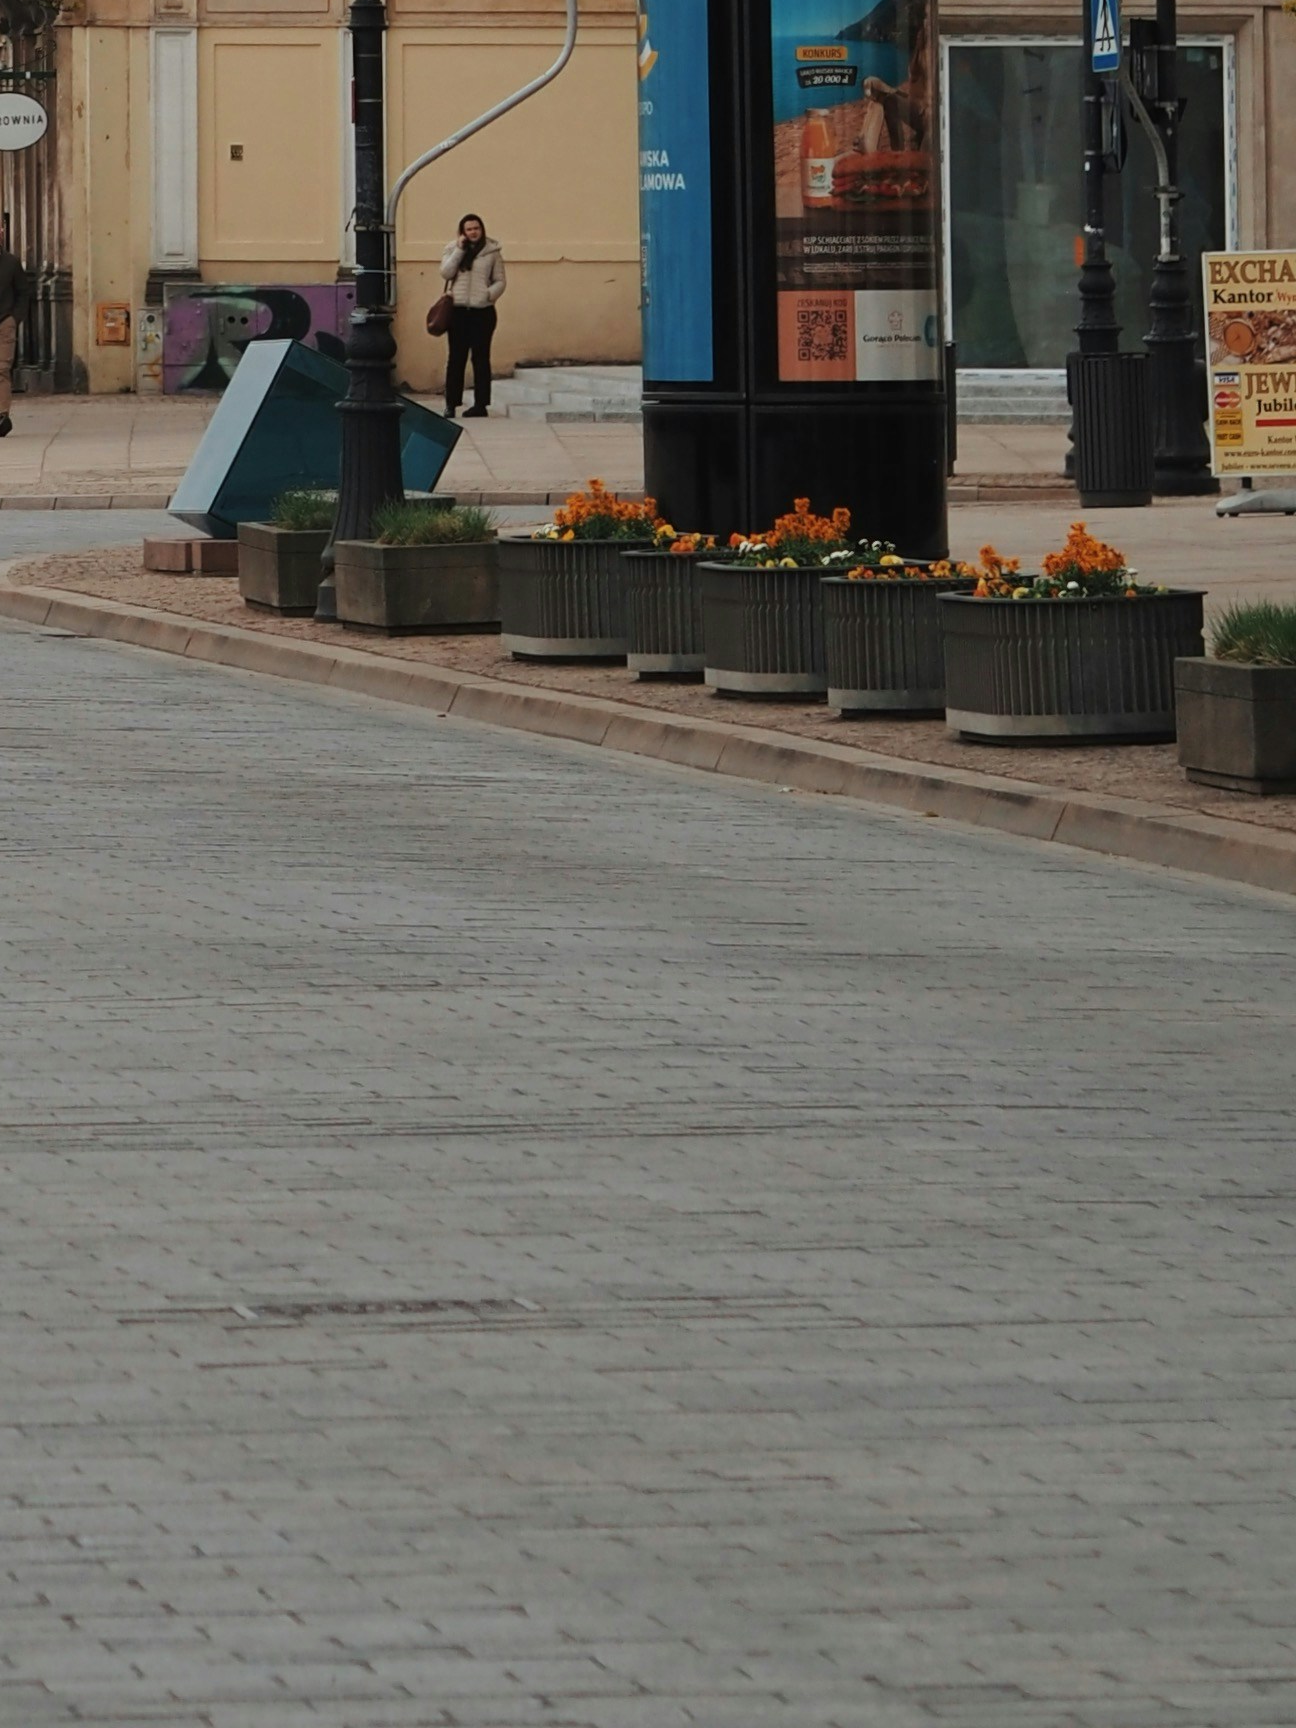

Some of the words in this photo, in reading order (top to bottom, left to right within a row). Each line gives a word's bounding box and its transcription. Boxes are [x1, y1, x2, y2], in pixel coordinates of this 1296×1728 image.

[802, 48, 842, 59] KONKURS
[1209, 259, 1296, 284] EXCHA
[1213, 288, 1273, 304] Kantor
[1245, 372, 1296, 400] JEW
[1256, 398, 1296, 416] Jubil
